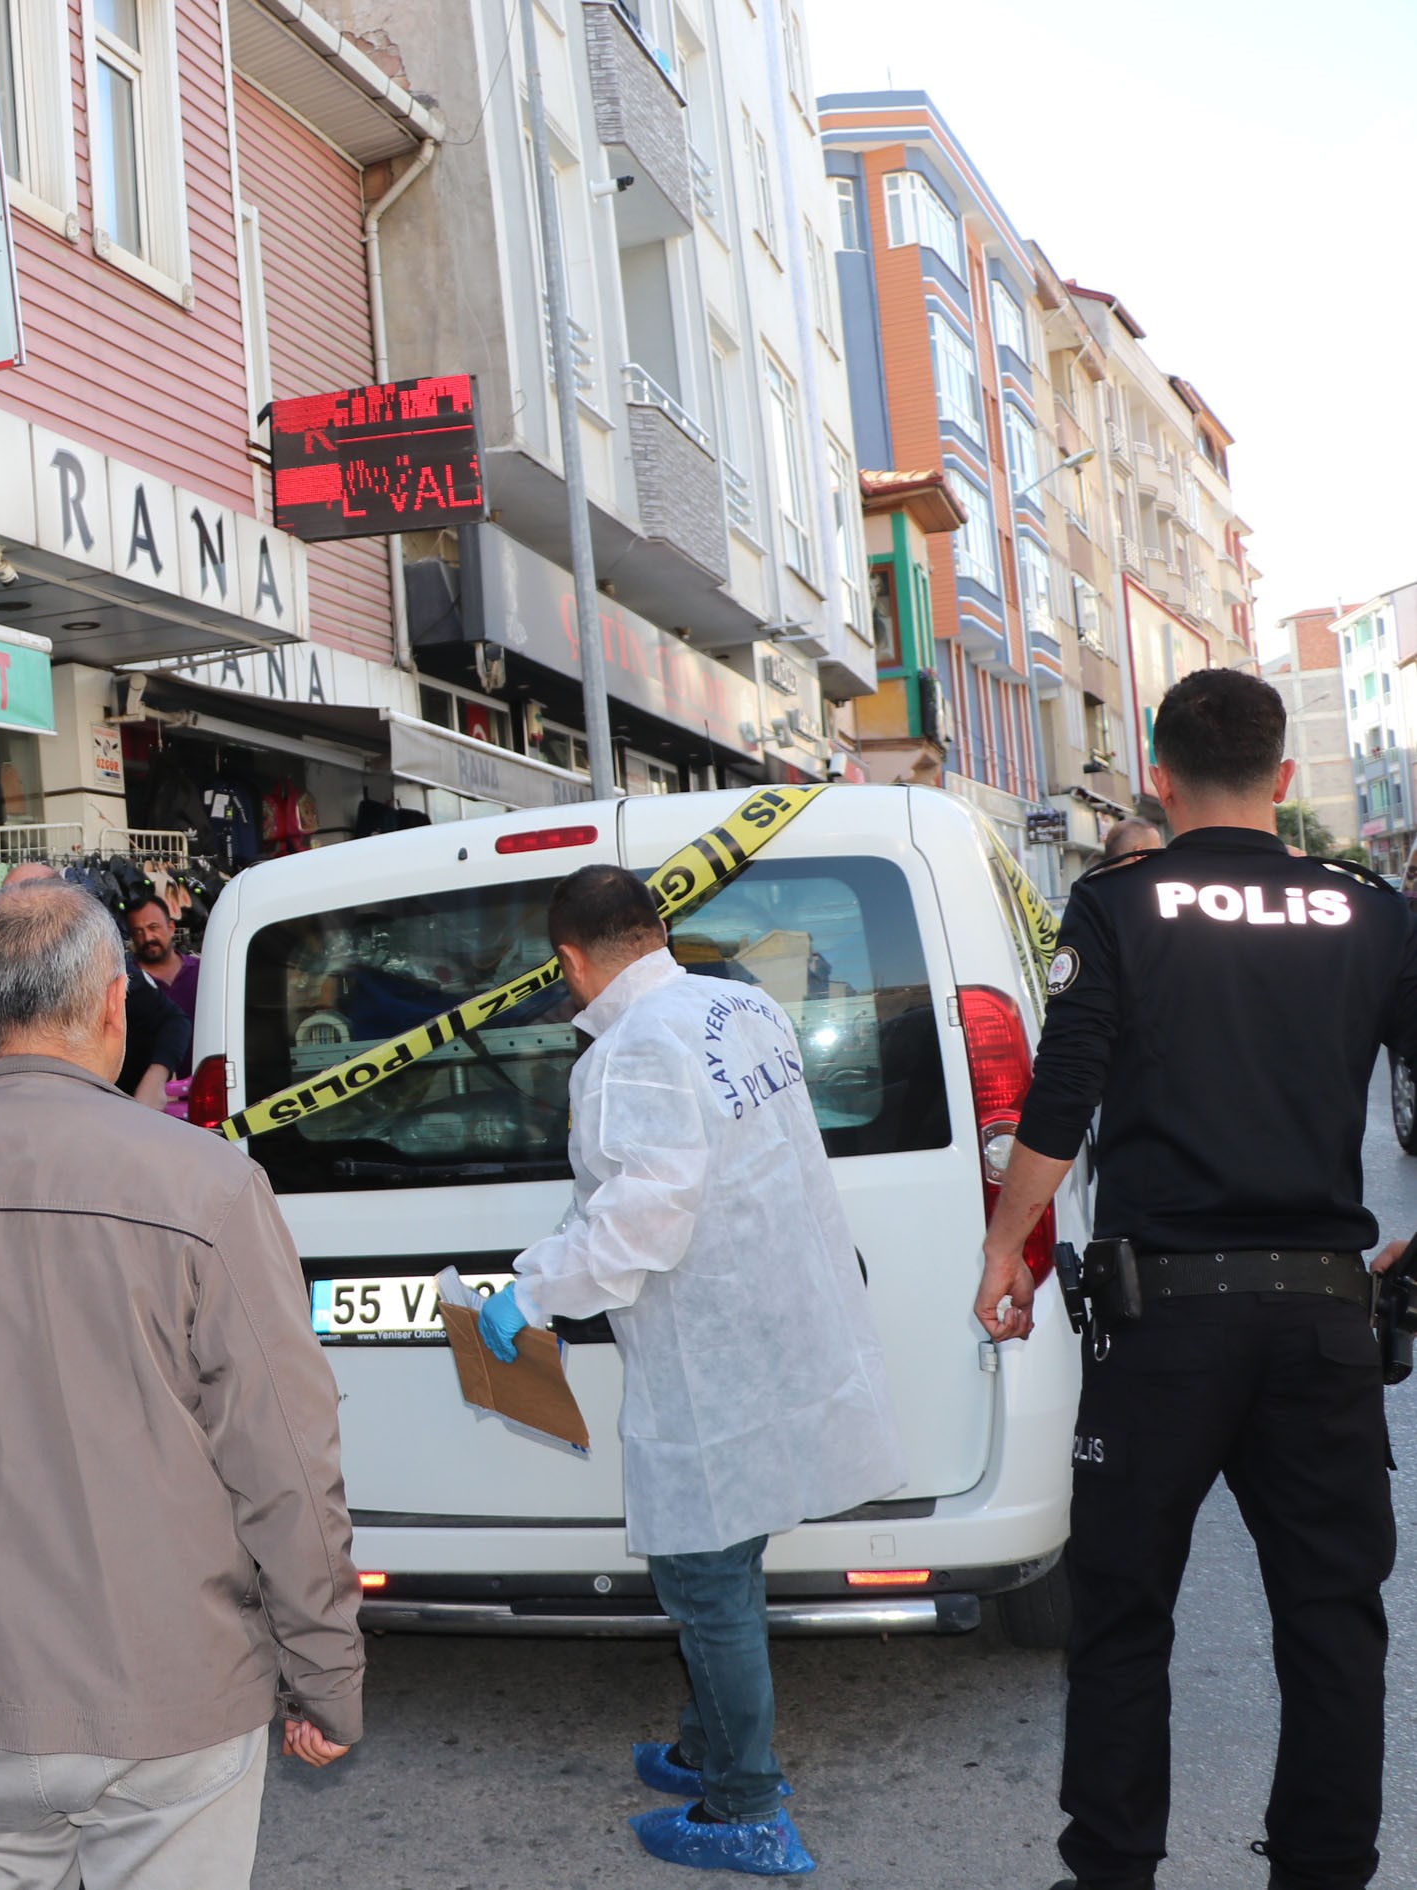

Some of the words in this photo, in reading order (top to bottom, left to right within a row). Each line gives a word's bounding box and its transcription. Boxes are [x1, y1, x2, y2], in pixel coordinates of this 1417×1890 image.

[50, 448, 285, 620] RANA
[456, 748, 500, 791] RANA
[1156, 881, 1352, 926] POLİS
[705, 999, 732, 1042] YERİ
[268, 1042, 415, 1125] POLİS
[705, 1051, 744, 1120] OLAY
[740, 1046, 803, 1109] POLİS
[333, 1285, 381, 1324] 55
